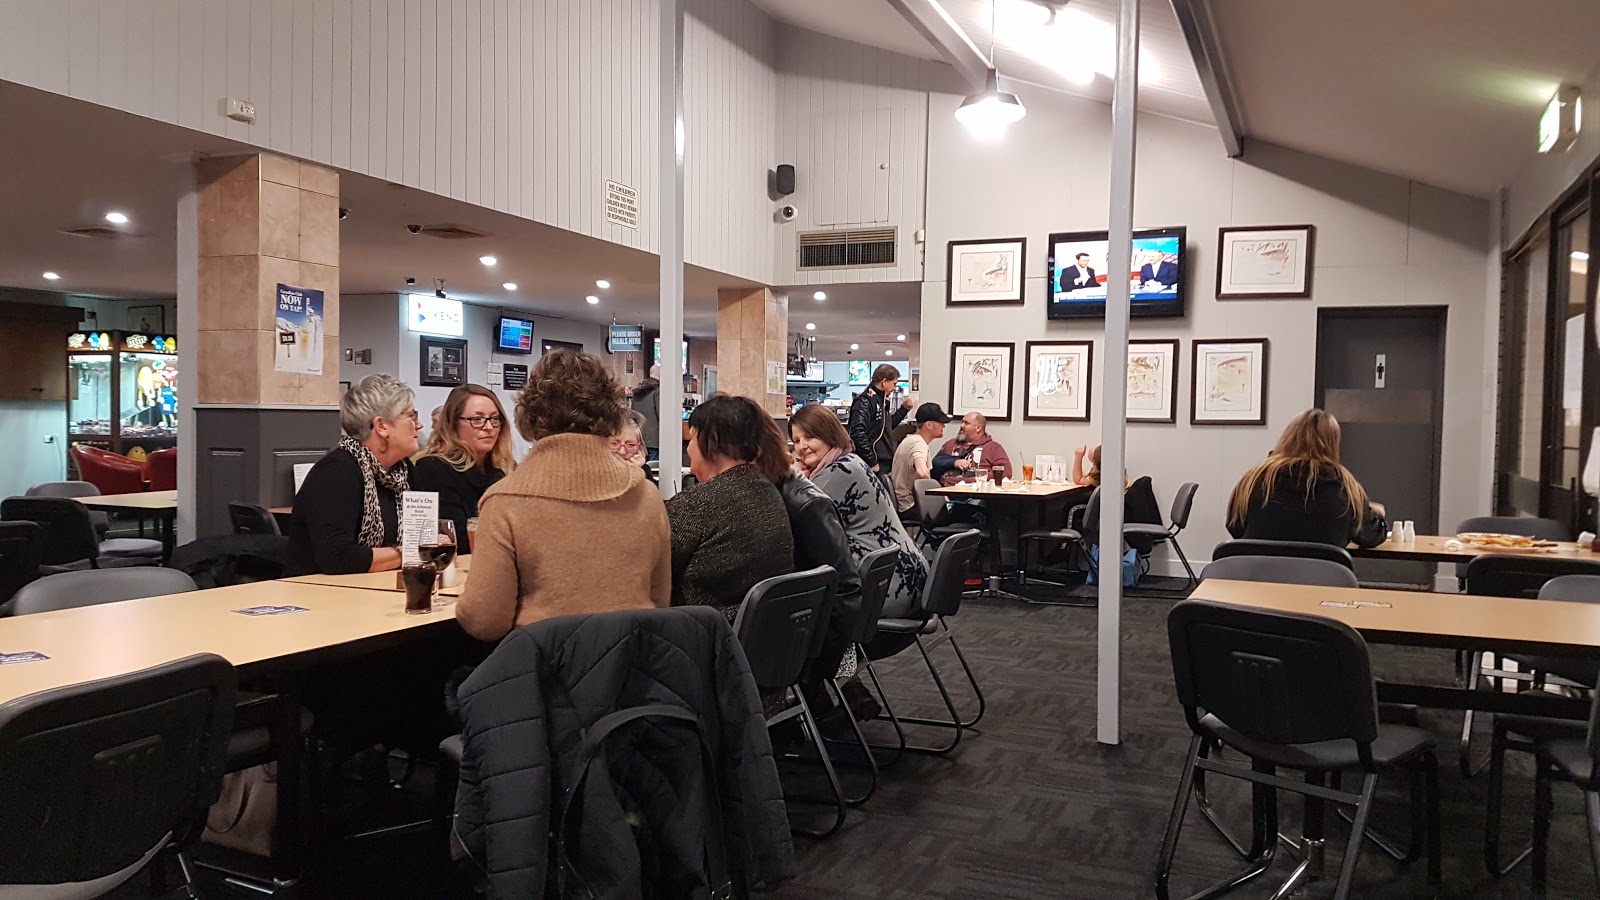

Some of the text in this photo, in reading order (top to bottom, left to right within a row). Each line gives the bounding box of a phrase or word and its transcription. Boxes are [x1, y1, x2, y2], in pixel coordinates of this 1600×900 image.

[616, 186, 635, 197] CHILDREN
[607, 198, 619, 207] CHILDREN
[280, 294, 302, 306] NOW
[612, 337, 641, 345] MEALS HERE
